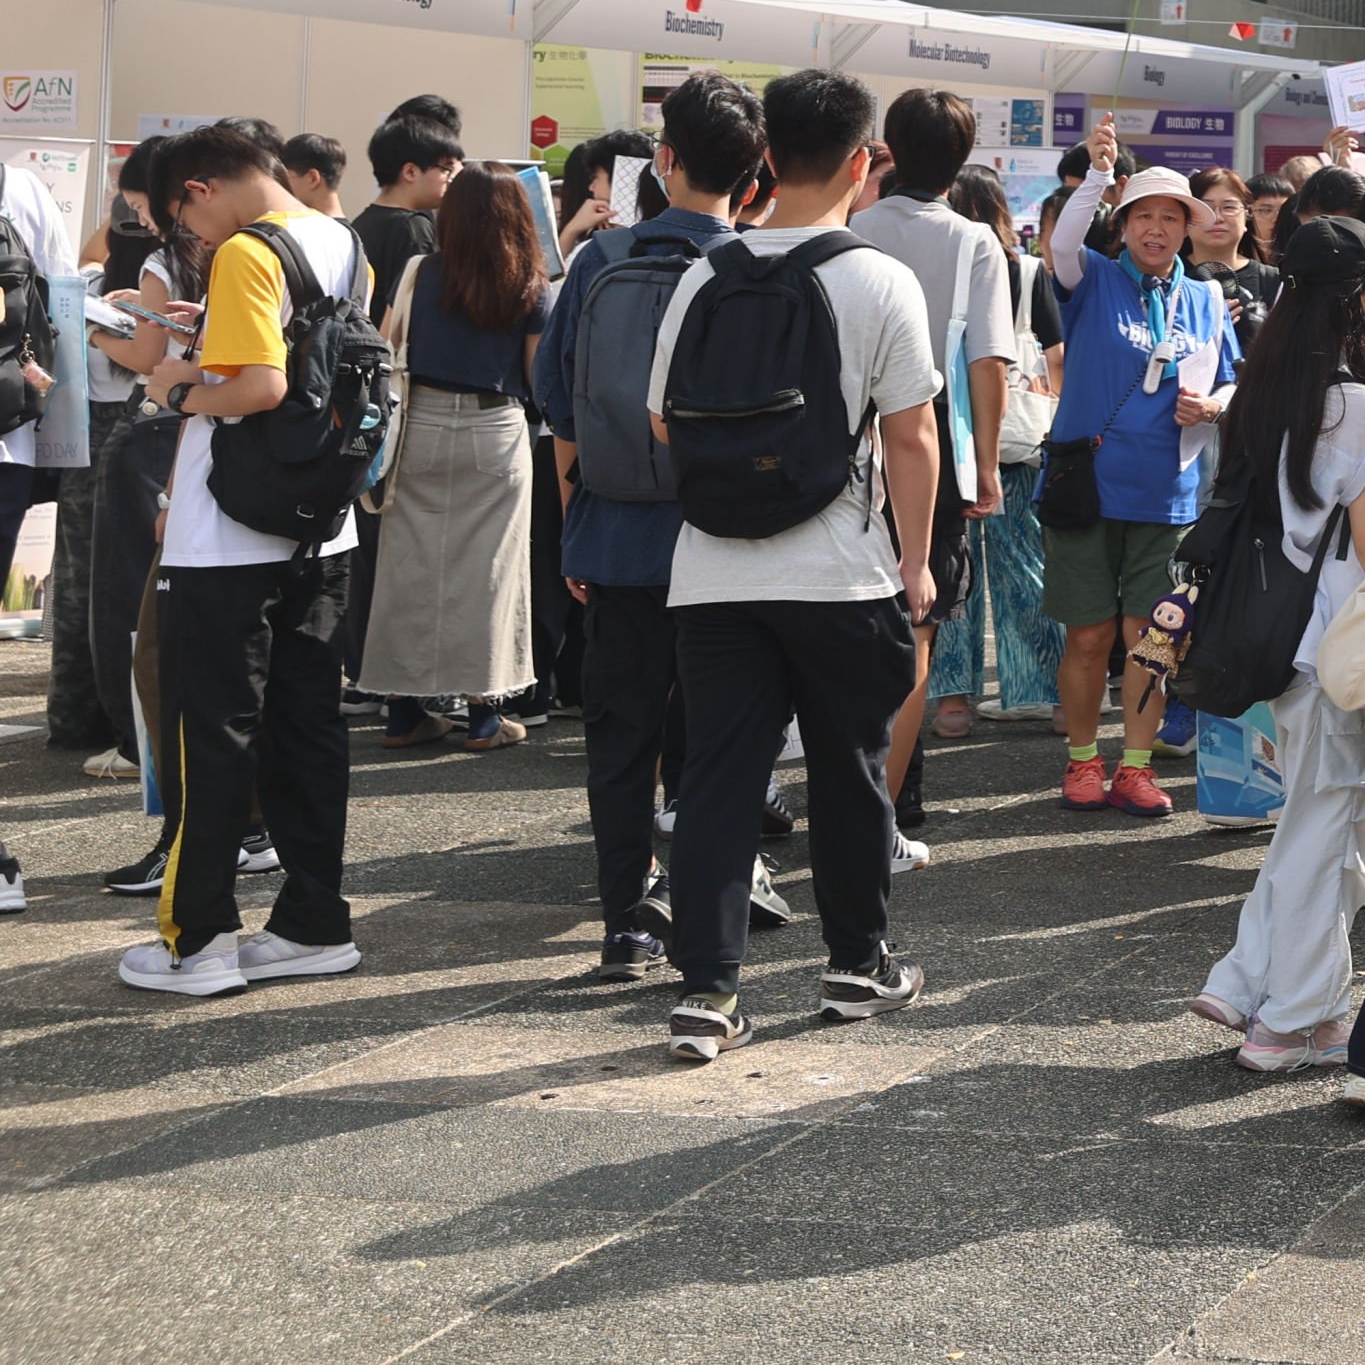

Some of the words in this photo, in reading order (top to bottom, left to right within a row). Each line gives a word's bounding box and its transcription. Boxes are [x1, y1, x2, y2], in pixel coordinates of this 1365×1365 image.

[665, 10, 725, 42] Biochemistry
[532, 49, 547, 63] ry
[908, 38, 942, 61] Molecular
[943, 43, 992, 70] Biotechnology
[1144, 65, 1165, 86] Biology
[34, 77, 72, 96] AfN
[1055, 113, 1075, 127] 生物
[1166, 116, 1202, 130] BIOLOGY
[1204, 117, 1225, 132] 生物
[35, 442, 50, 459] FO
[54, 443, 79, 459] DAY
[682, 998, 707, 1011] NIKE
